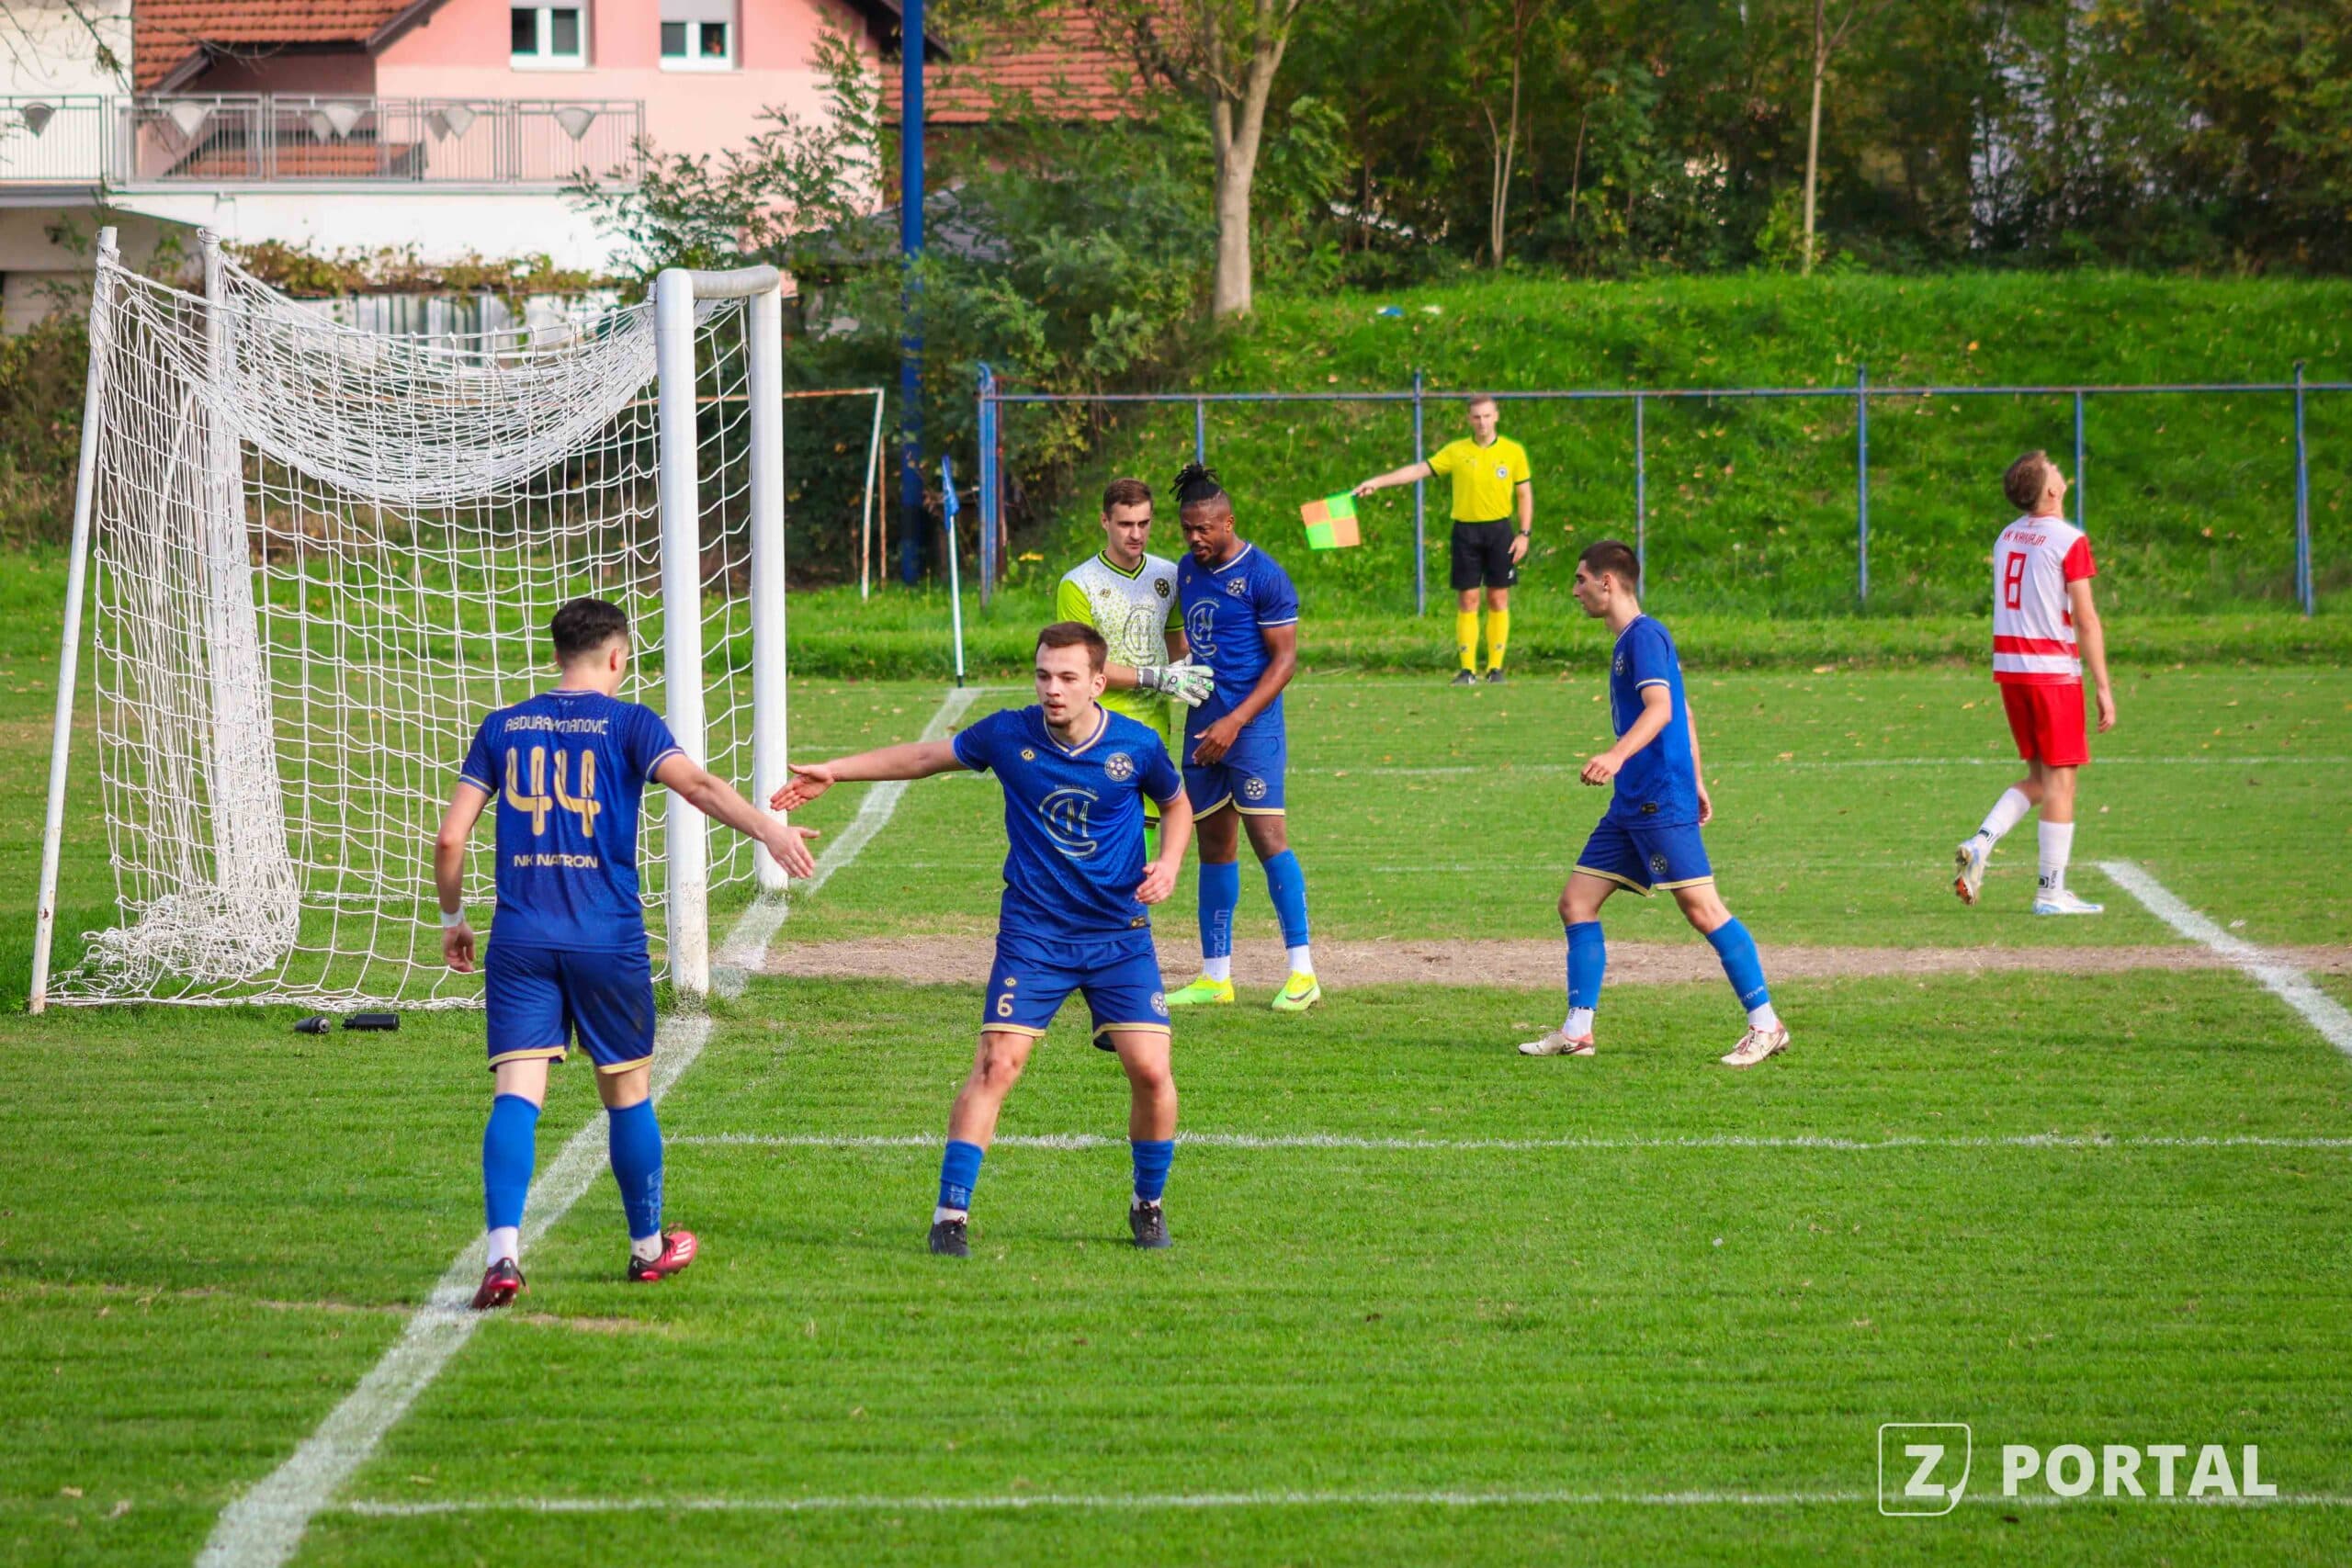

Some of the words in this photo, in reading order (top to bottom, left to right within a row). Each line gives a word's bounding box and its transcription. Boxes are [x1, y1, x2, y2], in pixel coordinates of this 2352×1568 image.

[2004, 551, 2027, 610] 8
[505, 746, 601, 838] 44
[514, 854, 534, 867] NK
[537, 853, 598, 868] NATRON
[997, 994, 1014, 1017] 6
